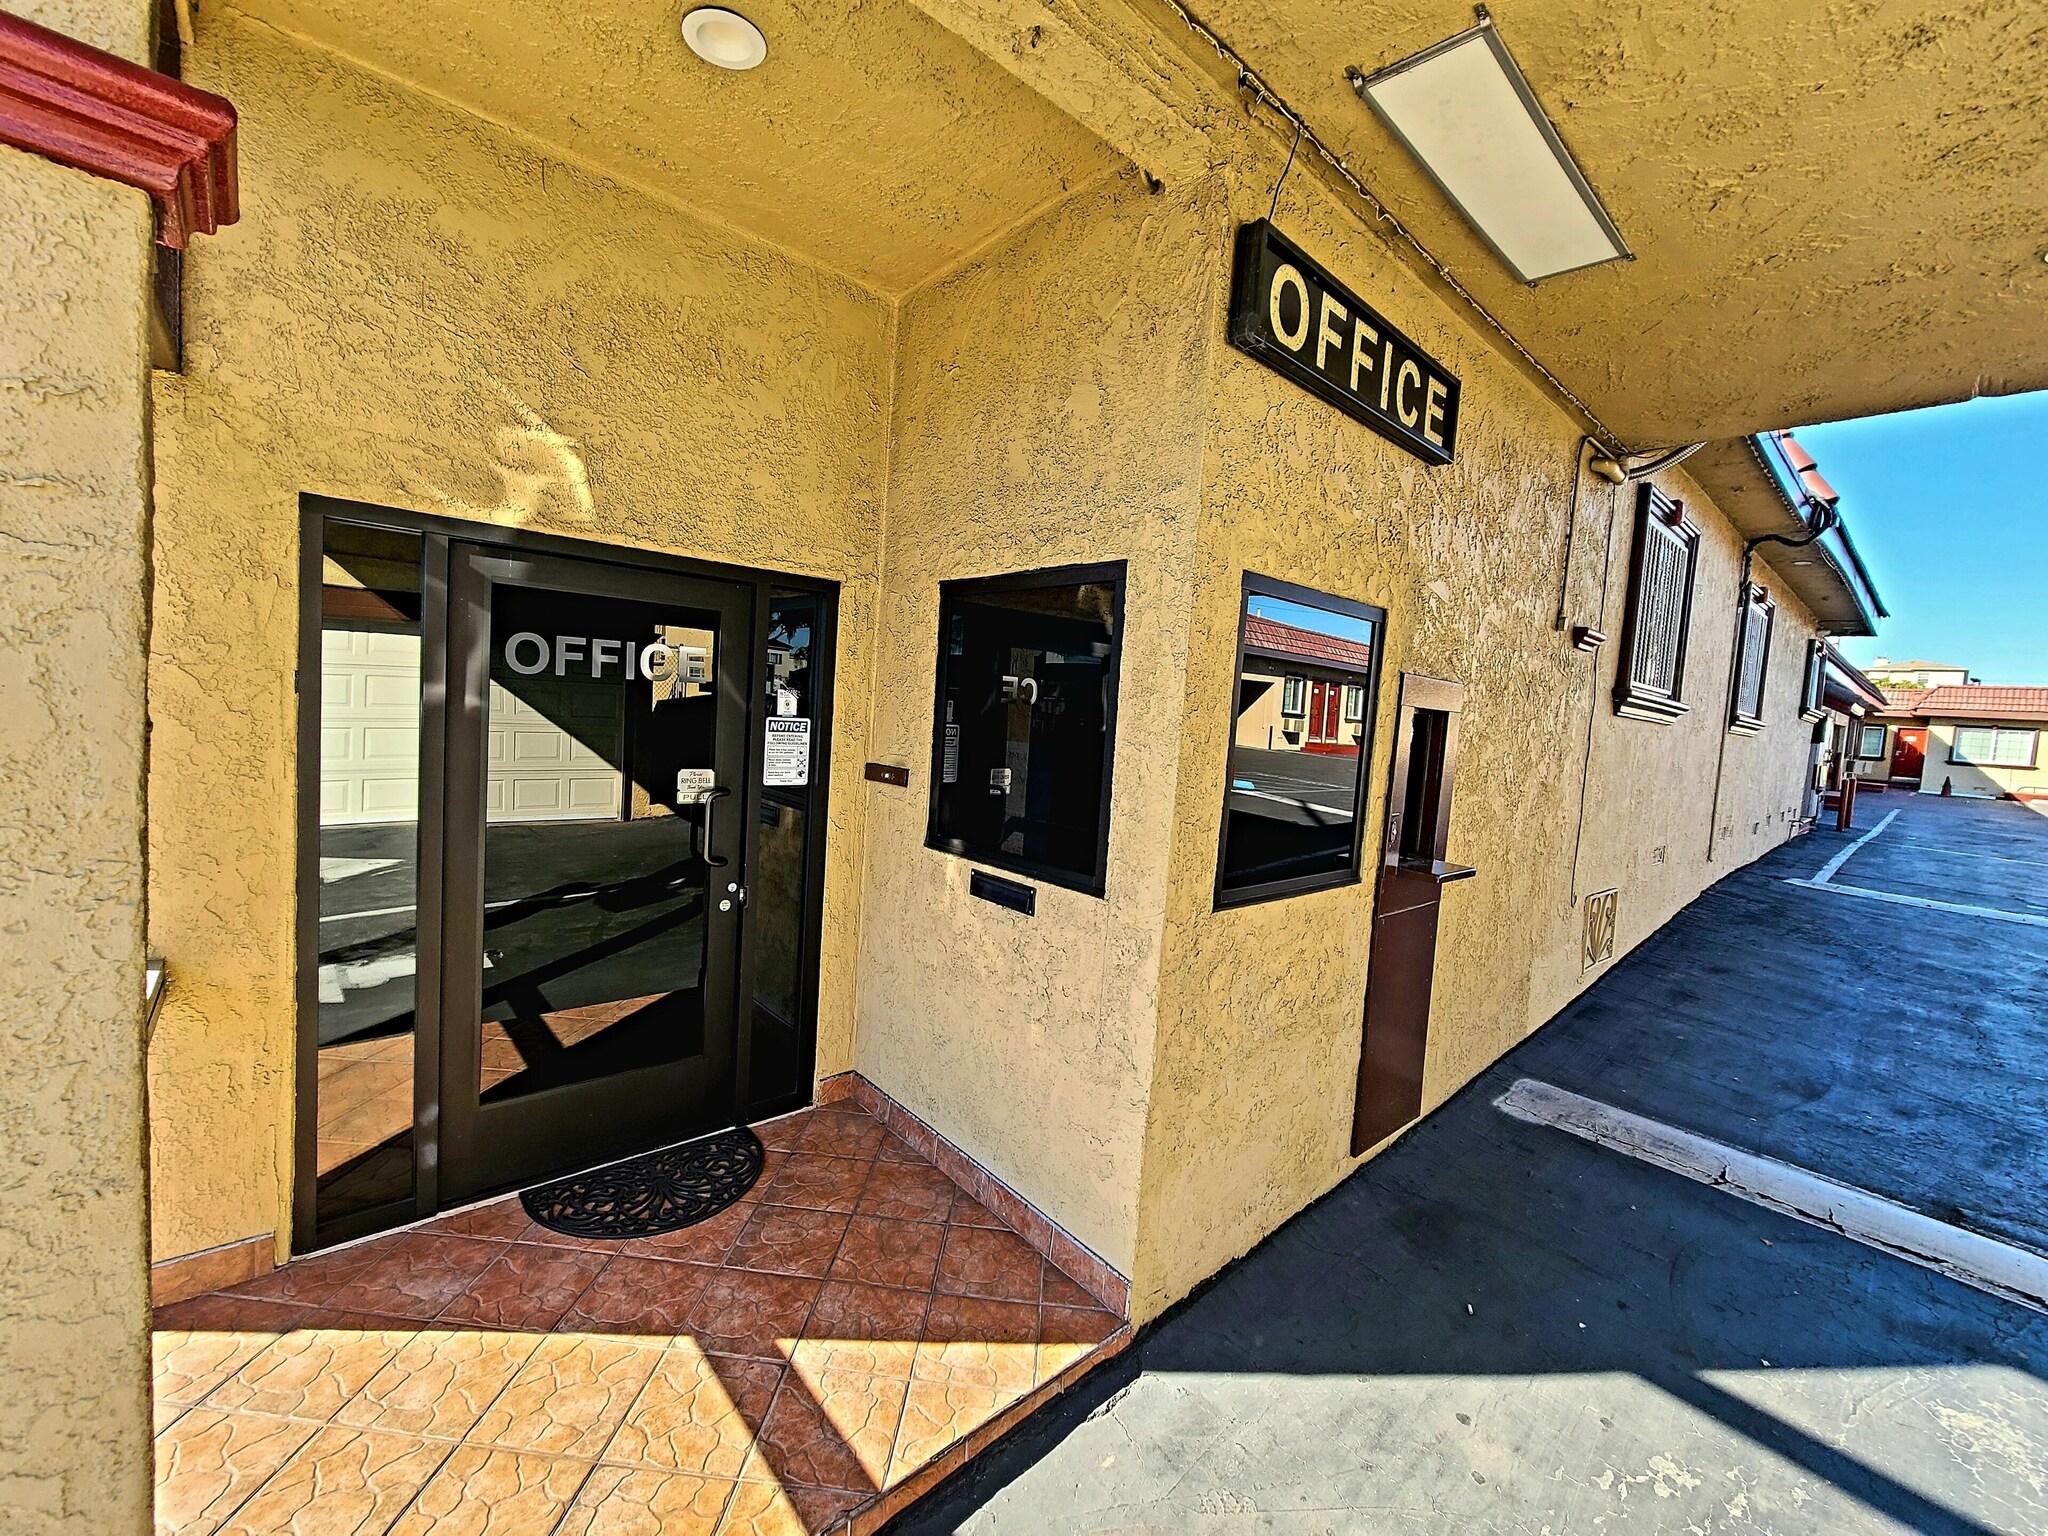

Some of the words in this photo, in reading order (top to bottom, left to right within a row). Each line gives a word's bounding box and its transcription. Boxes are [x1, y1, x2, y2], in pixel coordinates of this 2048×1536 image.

[1269, 263, 1448, 447] OFFICE
[504, 631, 707, 684] OFFICE
[769, 721, 807, 732] NOTICE
